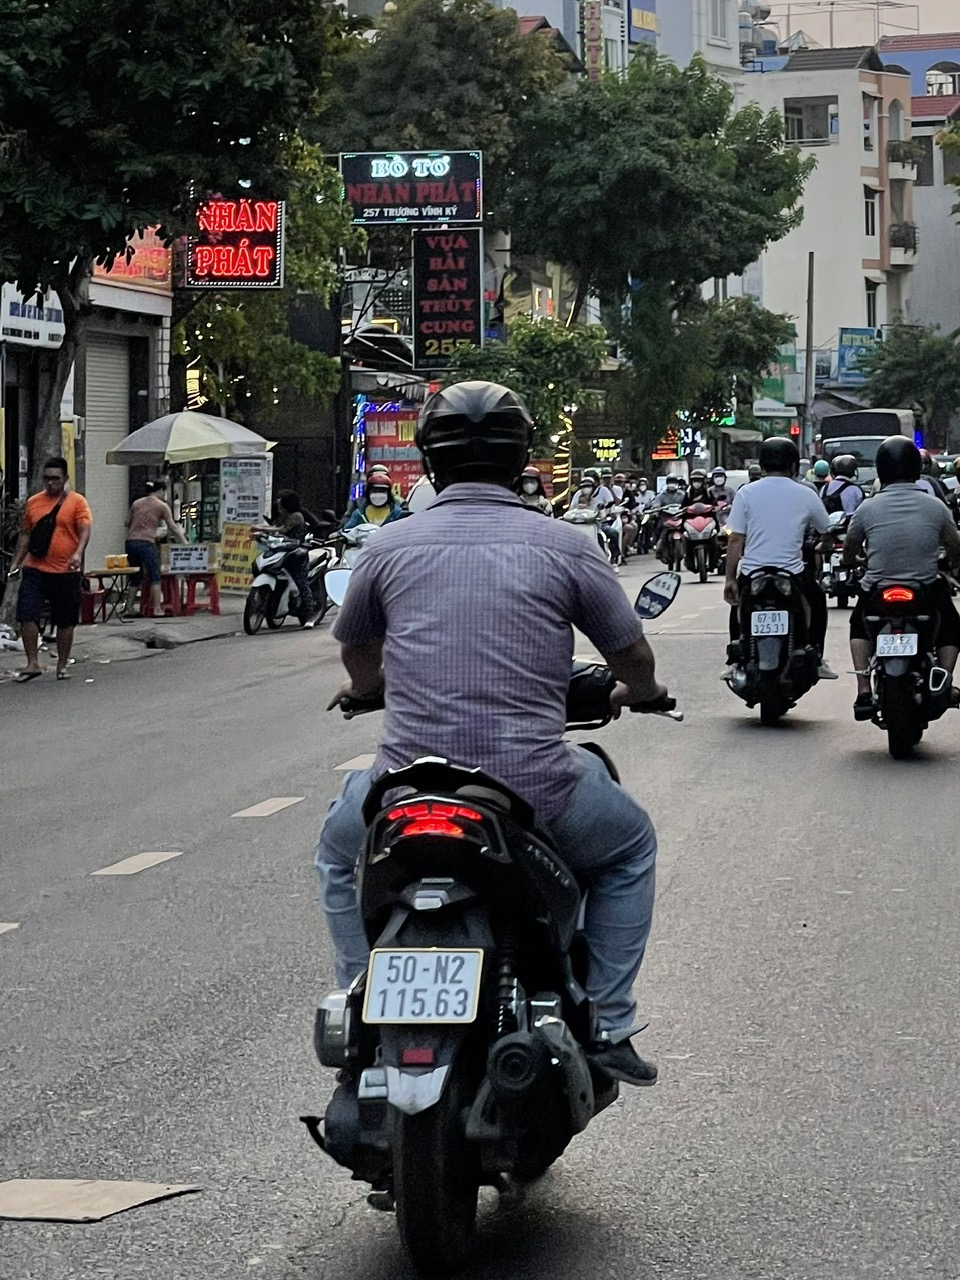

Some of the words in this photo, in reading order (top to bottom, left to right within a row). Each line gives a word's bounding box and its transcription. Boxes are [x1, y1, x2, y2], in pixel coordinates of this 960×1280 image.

[586, 1, 601, 82] HOTE
[371, 155, 408, 178] BÒ
[412, 155, 450, 178] TƠ
[416, 178, 474, 203] PHÁT
[363, 208, 381, 218] 257
[195, 238, 273, 276] PHÁT
[387, 955, 465, 985] 50-N2
[378, 988, 468, 1018] 115.63
